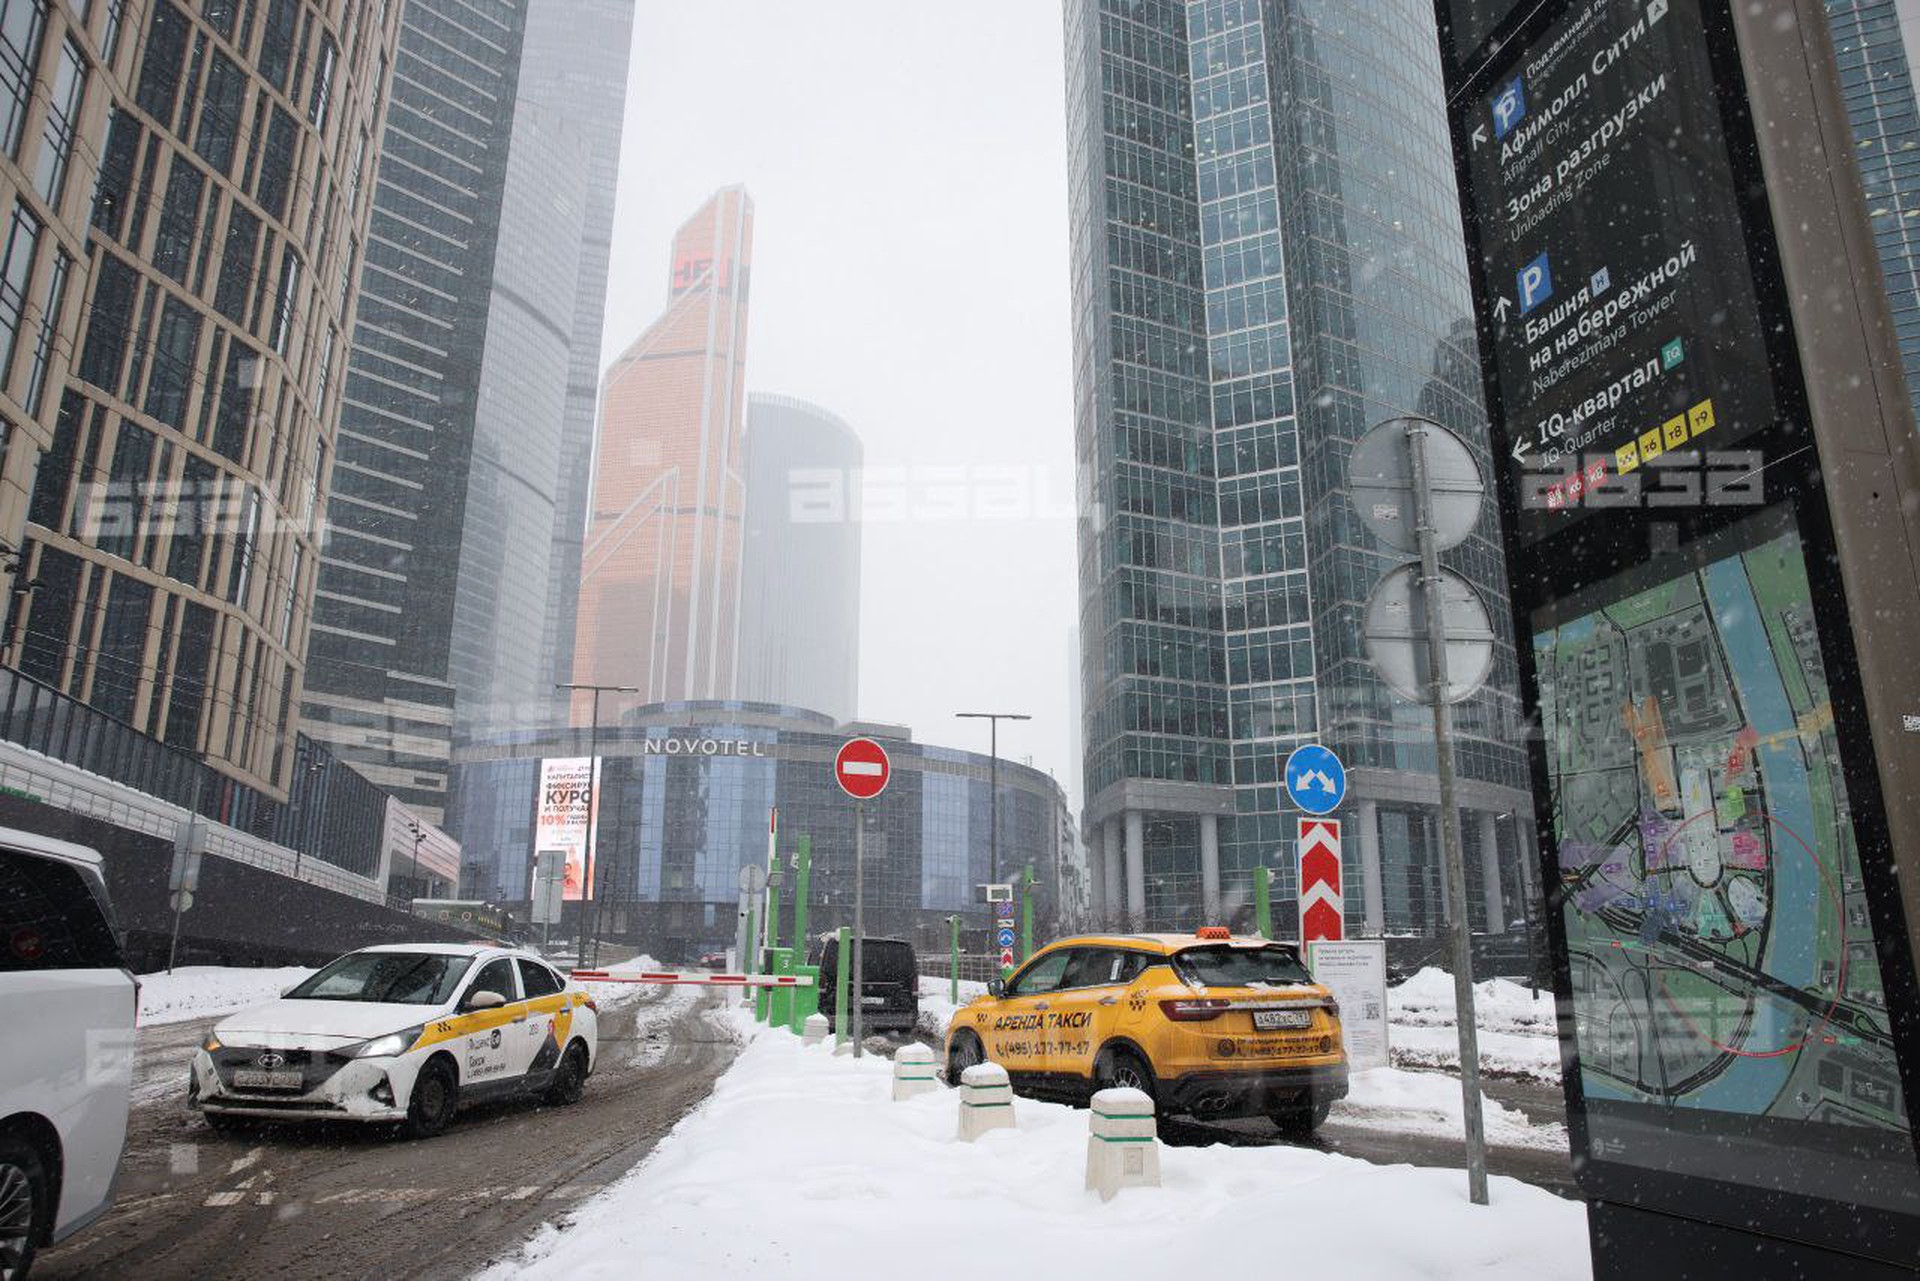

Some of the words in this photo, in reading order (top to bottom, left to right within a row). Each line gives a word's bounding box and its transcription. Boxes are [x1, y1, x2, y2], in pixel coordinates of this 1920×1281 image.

[1500, 73, 1588, 166] Афимолл
[1591, 18, 1646, 76] Сити
[1503, 145, 1544, 186] Afimall
[1546, 117, 1571, 145] City
[1506, 174, 1552, 222] Зона
[1555, 73, 1667, 184] разгрузки
[1511, 185, 1574, 242] Unloading
[1576, 152, 1611, 189] Zone
[1524, 286, 1589, 344] Башня
[1529, 347, 1551, 373] на
[1555, 240, 1696, 354] набережной
[1629, 290, 1678, 329] Tower
[1537, 358, 1660, 444] IQ-квартал
[1540, 415, 1616, 468] IQ-Quarter
[644, 738, 764, 756] NOVOTEL
[541, 814, 566, 825] 10%
[546, 790, 592, 805] КУРС
[994, 1014, 1044, 1031] АРЕНДА
[1048, 1012, 1092, 1029] ТАКСИ
